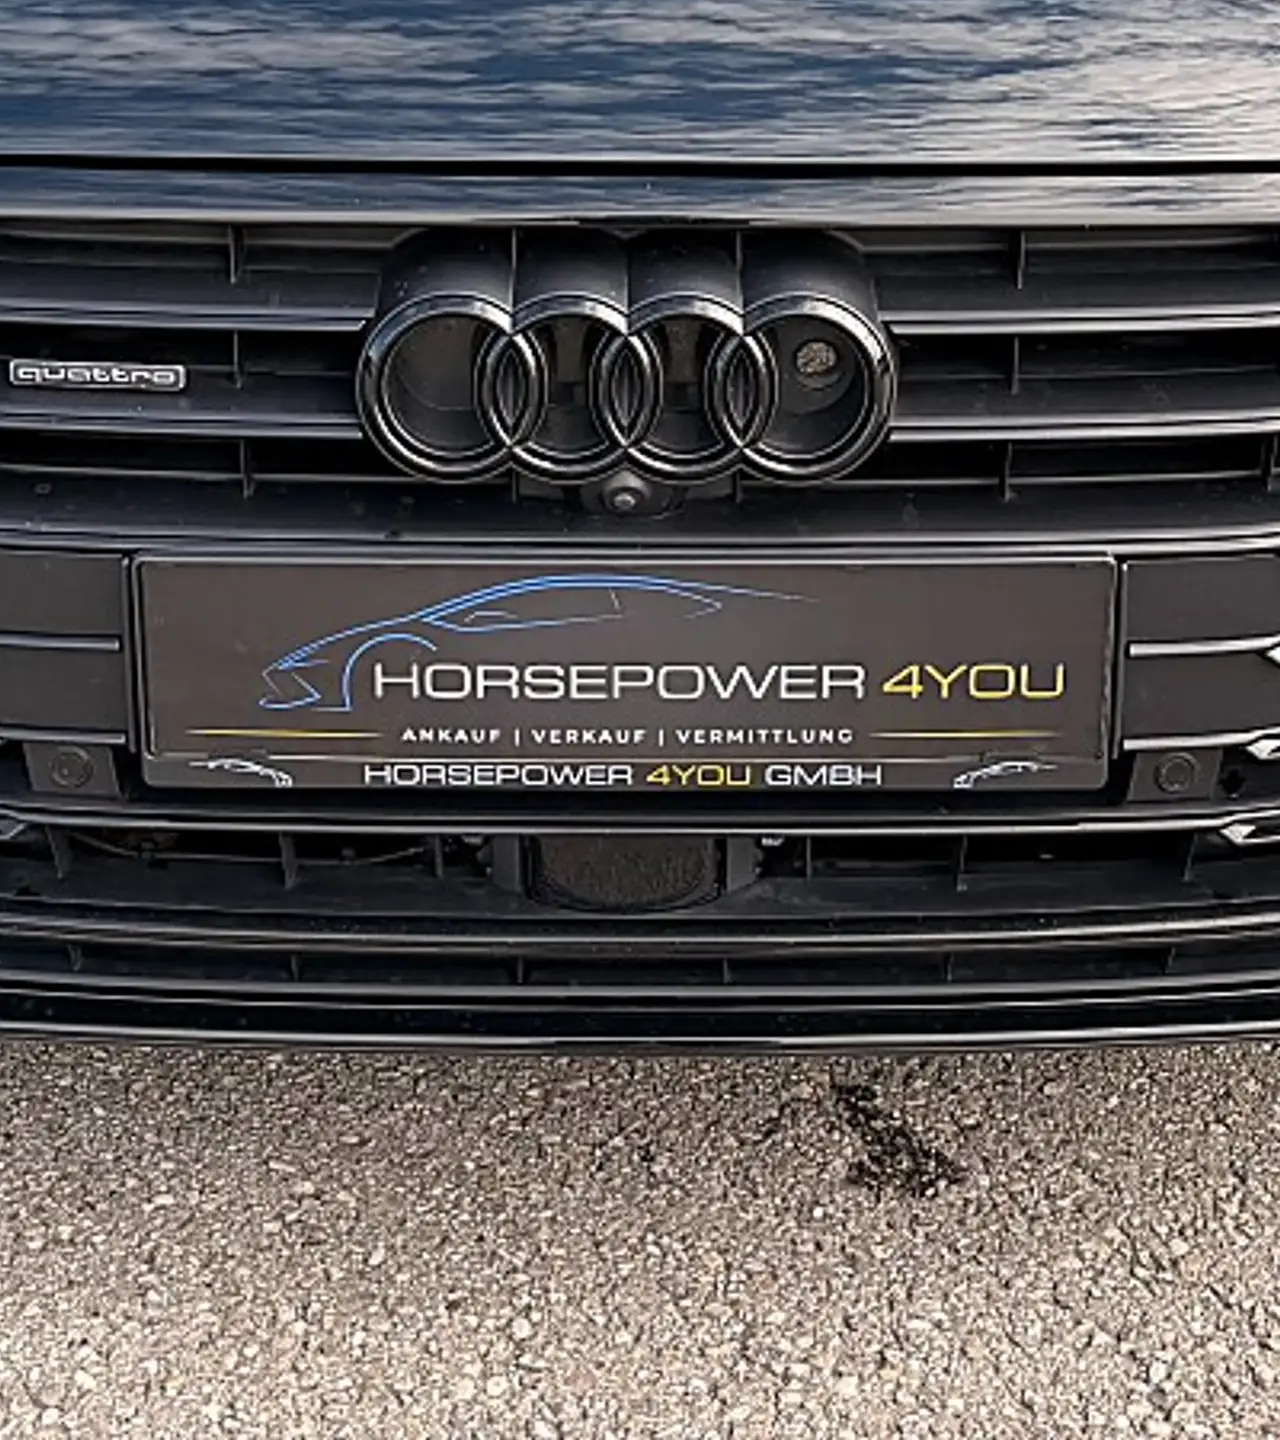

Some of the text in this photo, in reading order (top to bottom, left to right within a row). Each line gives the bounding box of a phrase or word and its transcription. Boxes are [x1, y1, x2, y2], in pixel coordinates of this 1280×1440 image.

[17, 367, 177, 385] quattro
[373, 662, 1065, 700] HORSEPOWER 4YOU
[401, 726, 501, 744] ANKAUF
[531, 727, 647, 745] VERKAUF
[675, 727, 854, 745] VERMITTLUNG
[364, 763, 883, 787] HORSEPOWER 4YOU GMBH
